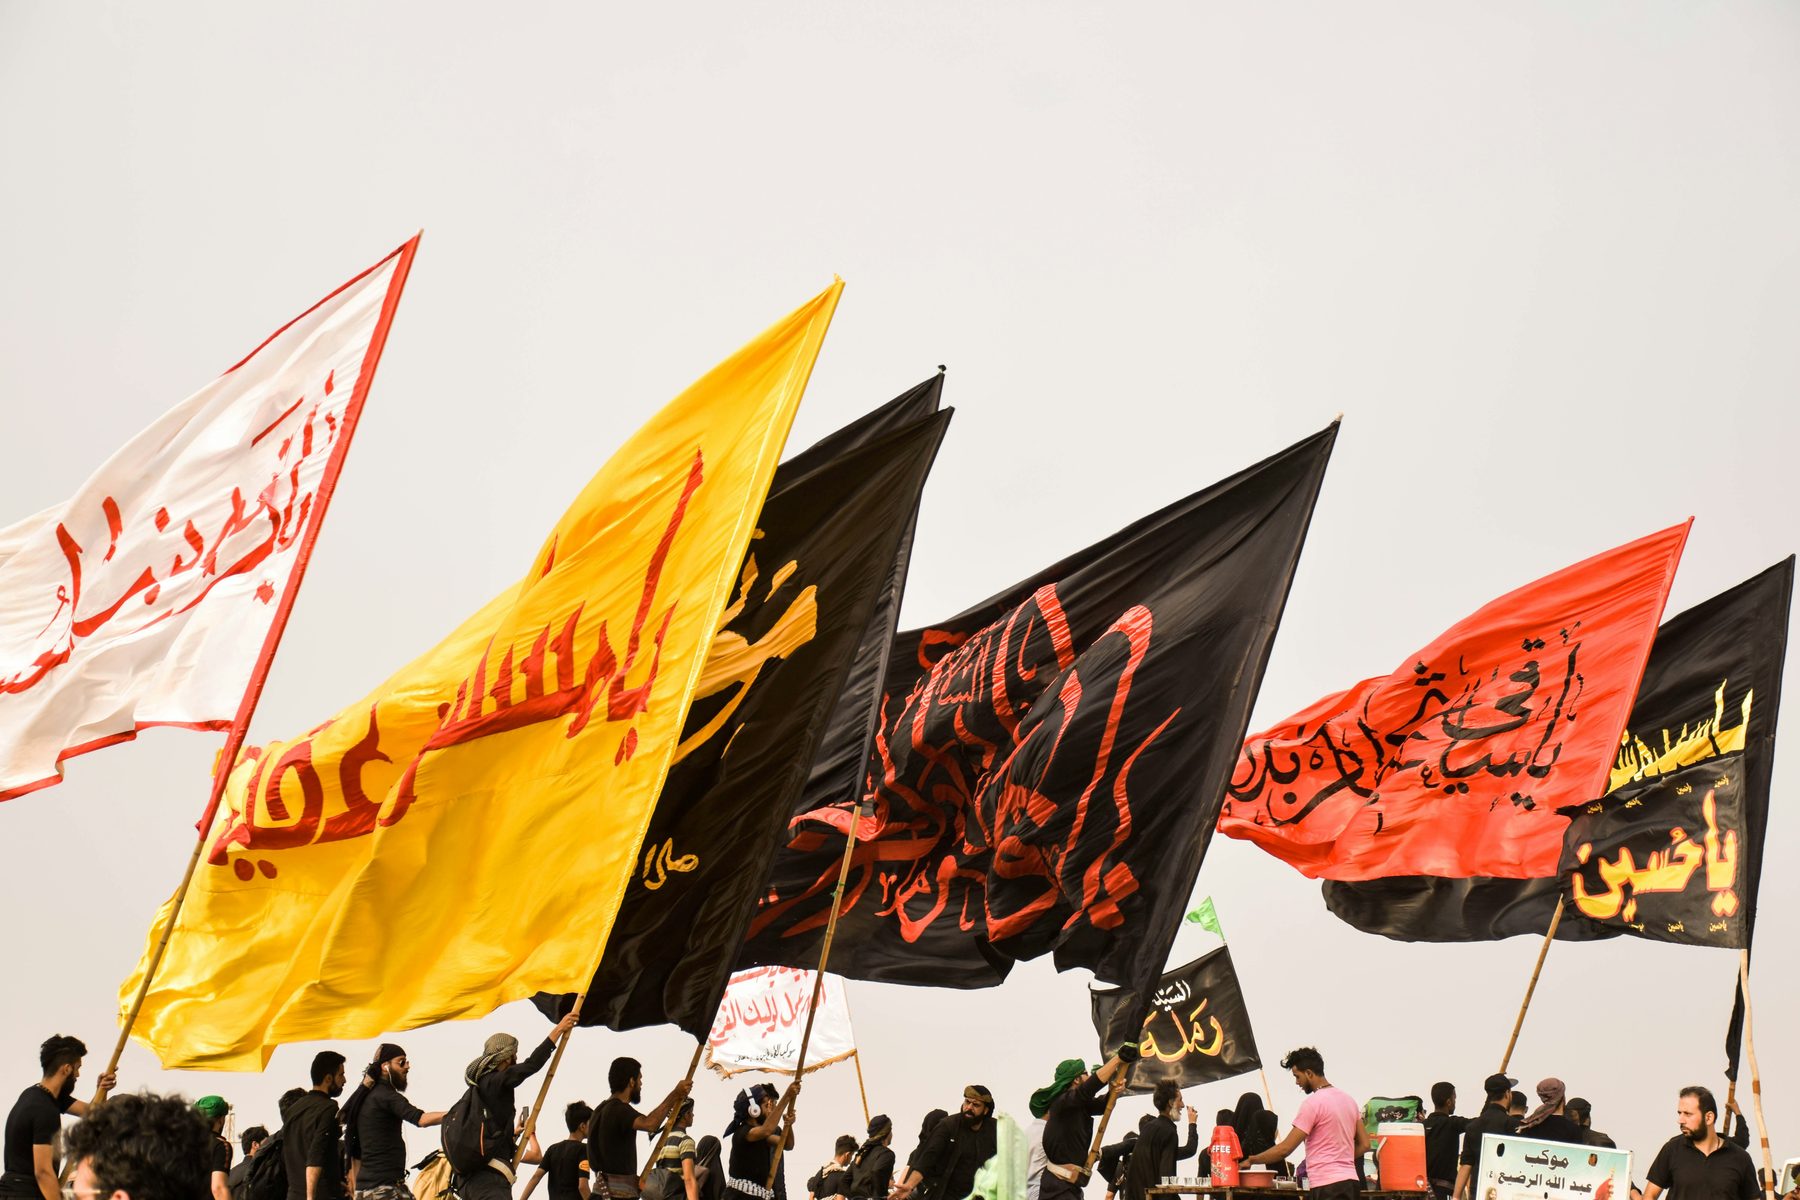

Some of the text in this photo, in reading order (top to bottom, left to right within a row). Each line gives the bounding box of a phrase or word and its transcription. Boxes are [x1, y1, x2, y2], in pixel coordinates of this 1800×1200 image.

[1524, 1149, 1569, 1170] موكب
[1497, 1170, 1543, 1188] الرضيع
[1545, 1174, 1565, 1190] الله
[1569, 1180, 1593, 1196] عبد
